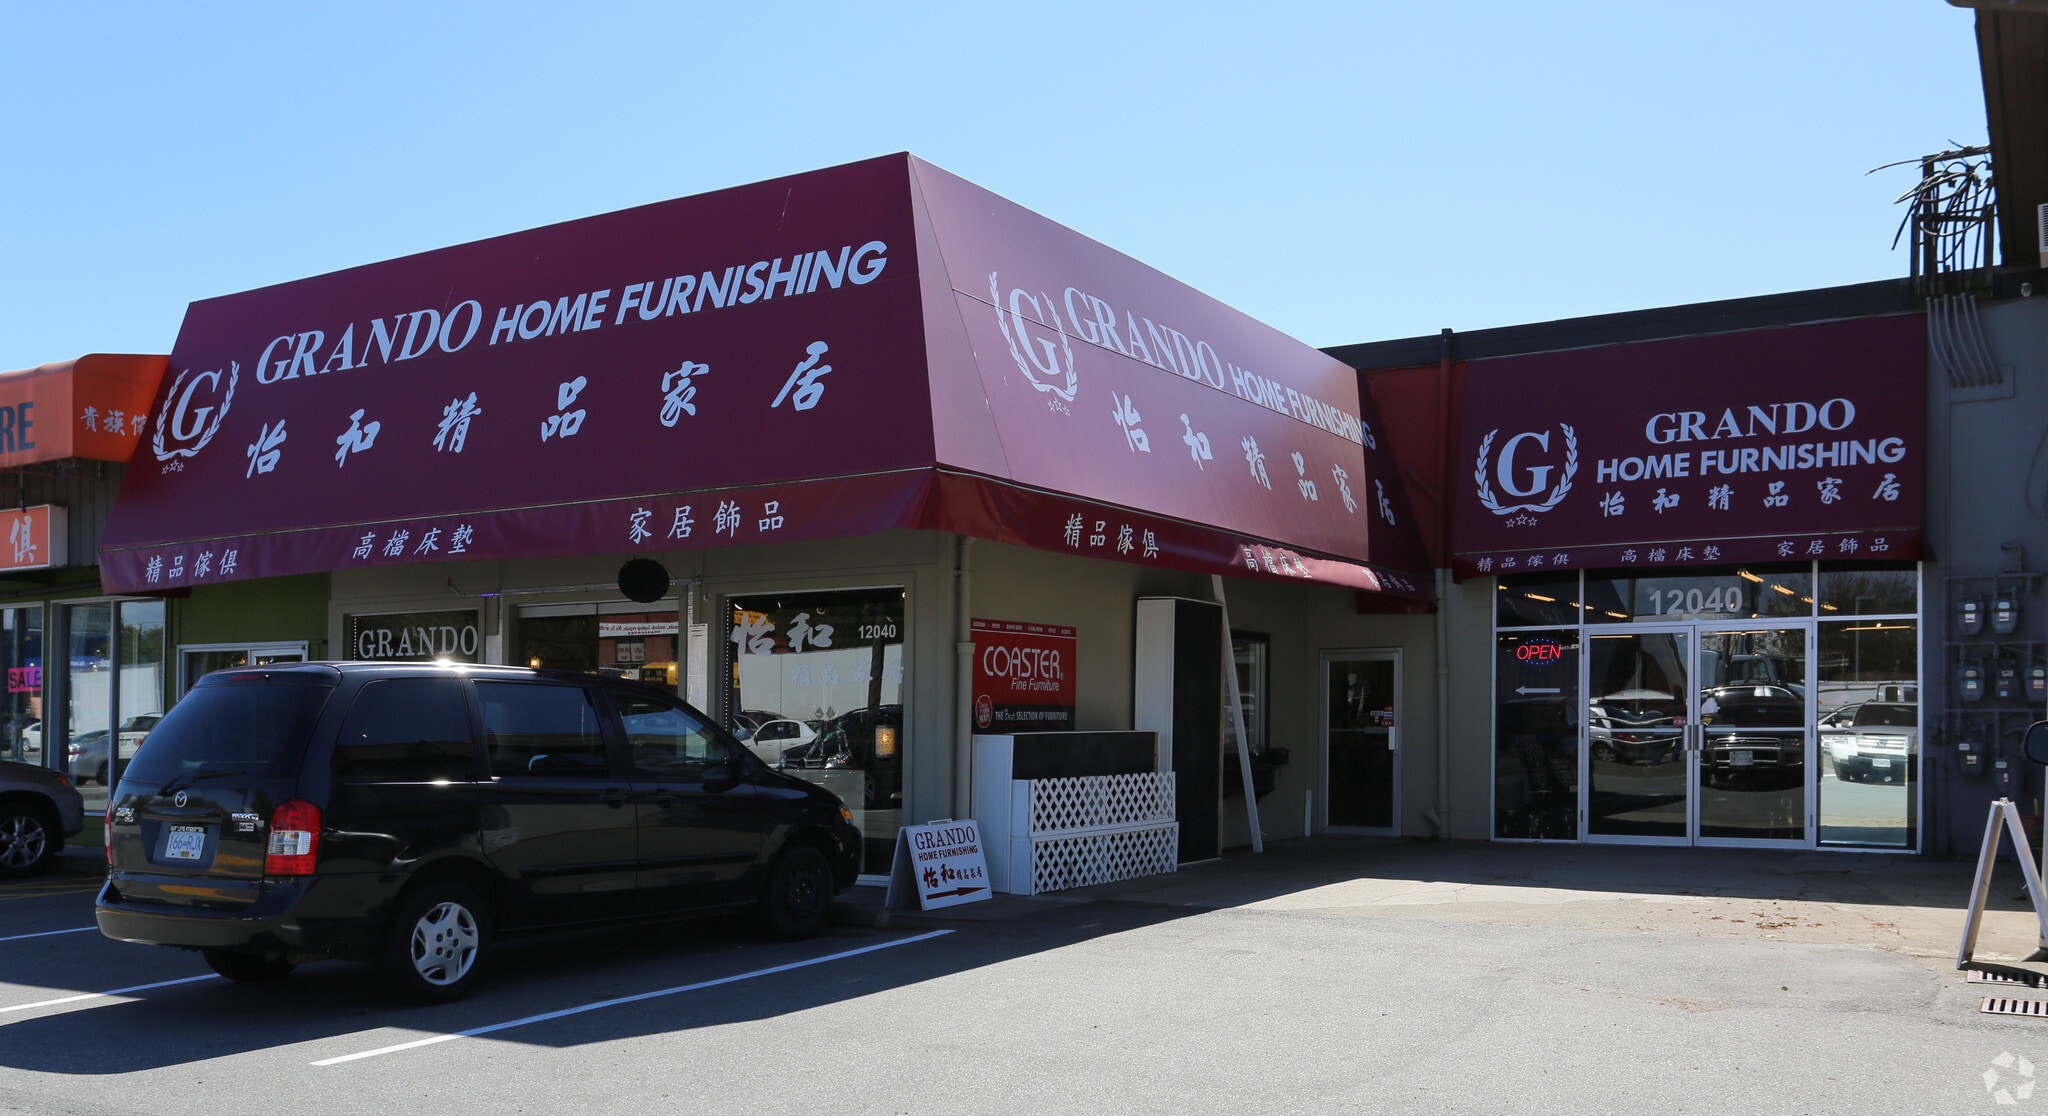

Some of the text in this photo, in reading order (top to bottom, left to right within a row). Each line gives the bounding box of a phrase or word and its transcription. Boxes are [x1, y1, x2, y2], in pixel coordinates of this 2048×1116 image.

[256, 240, 888, 385] GRANDO HOME FURNISHING
[1009, 287, 1057, 376] G
[1064, 286, 1377, 451] GRANDO HOME FURNISHING
[171, 370, 223, 442] G
[246, 340, 833, 479] 怡和精品家居
[1646, 398, 1856, 444] GRANDO
[1112, 390, 1396, 527] 怡和精品家居
[1496, 429, 1555, 497] G
[1596, 437, 1907, 484] HOME FURNISHING
[1600, 473, 1901, 518] 怡和精品家居
[146, 499, 785, 583] 精品傢俱 高檔床墊 家居飾品
[1064, 512, 1160, 560] 精品傢俱
[1777, 538, 1889, 556] 家居飾品
[1649, 586, 1744, 617] 12040
[358, 625, 479, 659] GRANDO
[730, 612, 834, 657] 怡和
[858, 624, 897, 640] 12040
[1516, 644, 1562, 660] OPEN
[9, 670, 41, 688] SALE
[983, 646, 1060, 679] COASTER
[1011, 678, 1060, 692] Fine Furniture
[995, 711, 1004, 720] THE
[1016, 711, 1039, 721] SELECTION
[1045, 711, 1068, 721] FURNITURE
[915, 826, 976, 850] GRANDO
[918, 845, 979, 861] HOME FURNISHING
